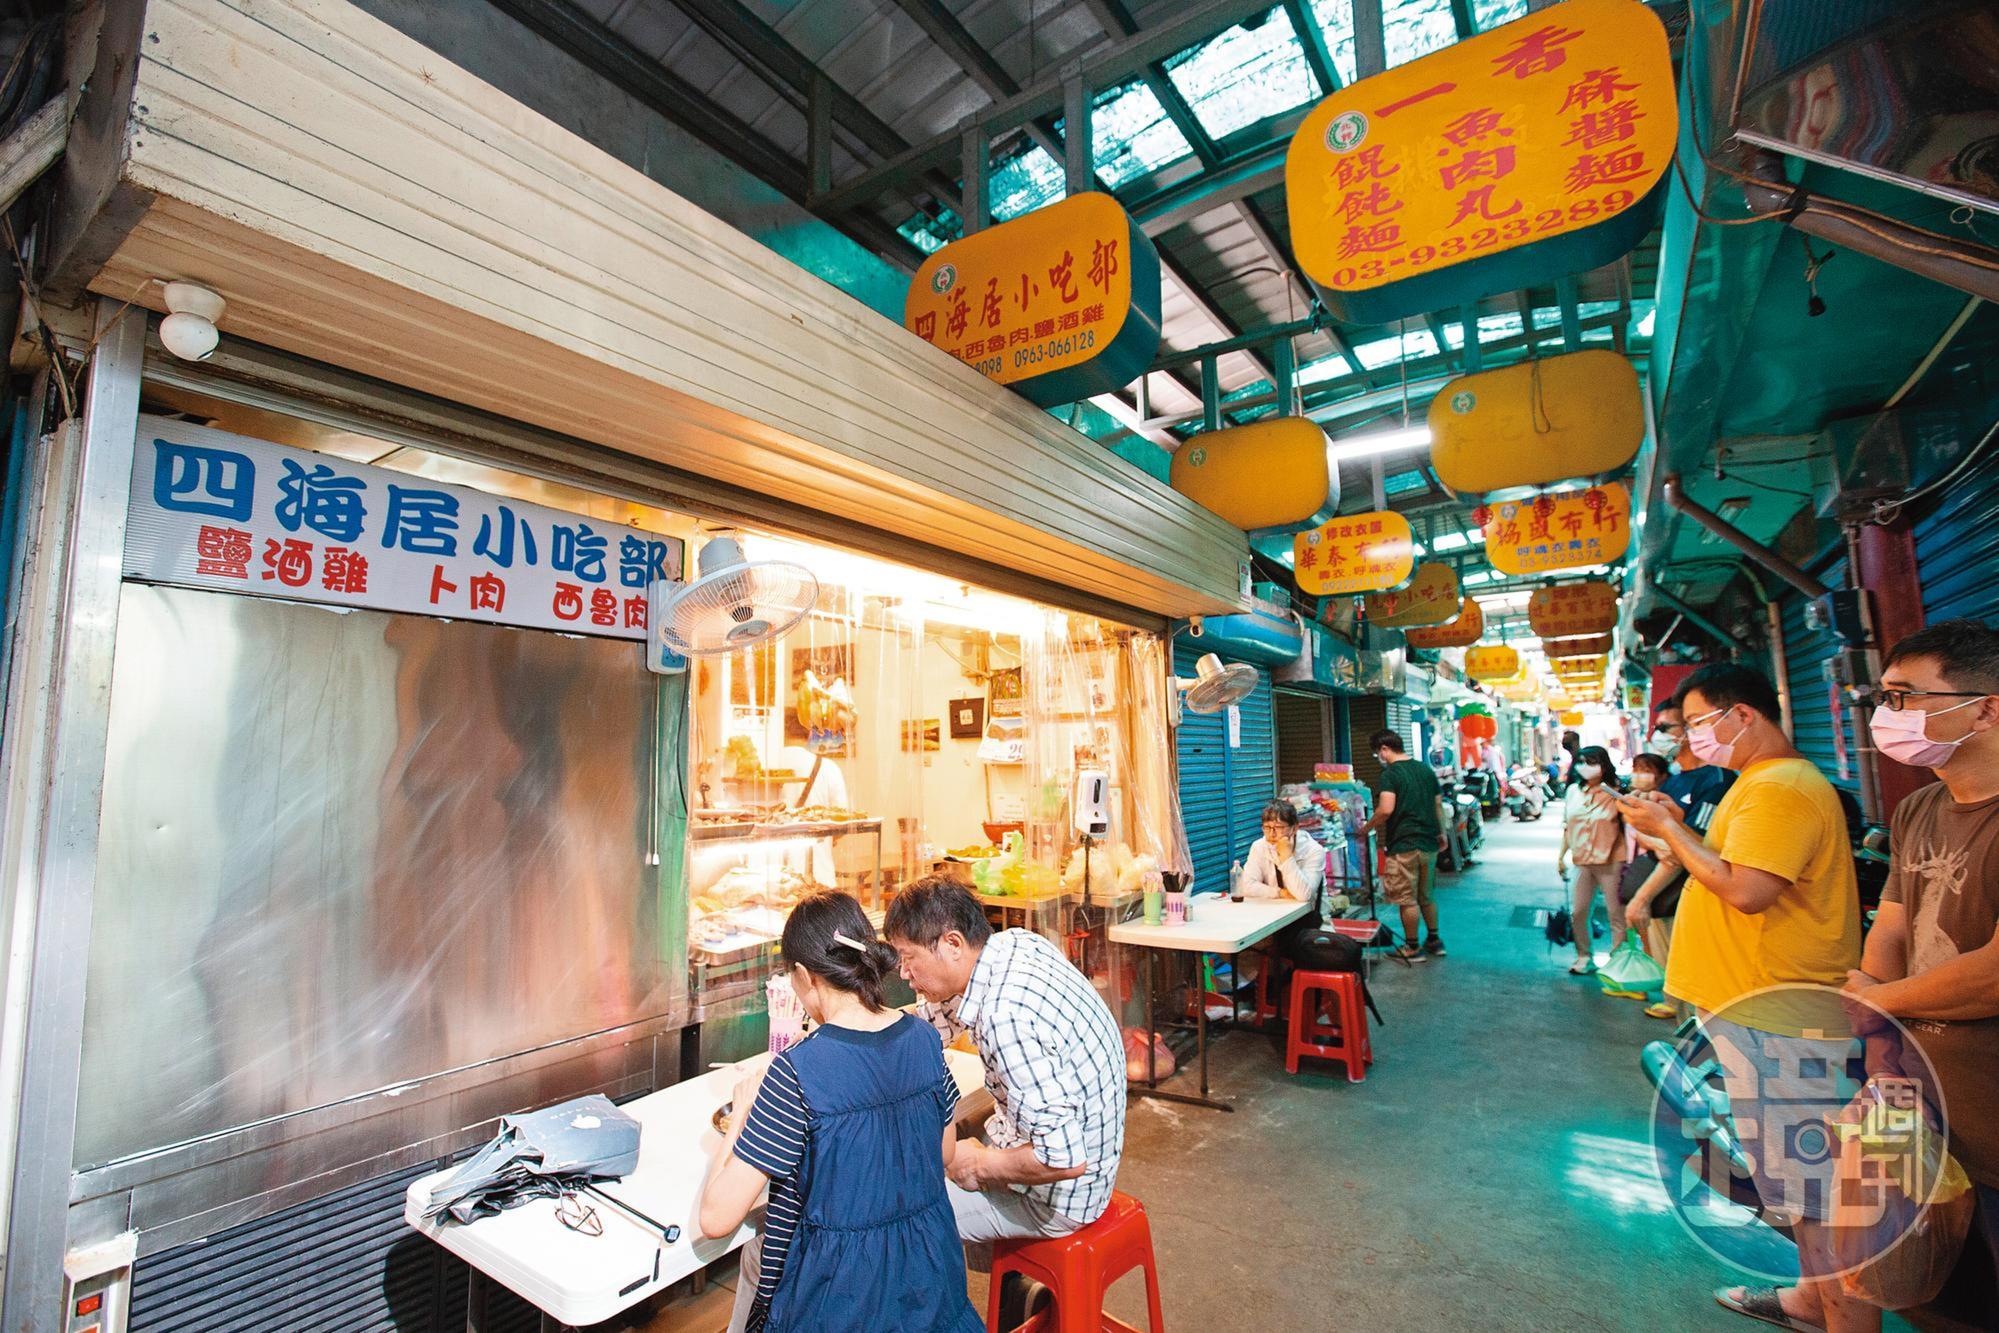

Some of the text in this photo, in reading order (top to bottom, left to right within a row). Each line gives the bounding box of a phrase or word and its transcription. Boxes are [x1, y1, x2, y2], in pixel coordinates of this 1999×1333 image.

[1556, 66, 1653, 195] 麻醬麵
[1330, 144, 1406, 261] 餛飩麵
[1333, 189, 1635, 287] 03-9323289
[914, 239, 1118, 342] 四海居小吃部
[1014, 330, 1095, 368] 0963-066128
[153, 438, 667, 588] 四海居小吃部
[196, 524, 368, 595] 鹽酒雞
[429, 564, 507, 613] 卜肉
[552, 581, 648, 631] 西魯肉
